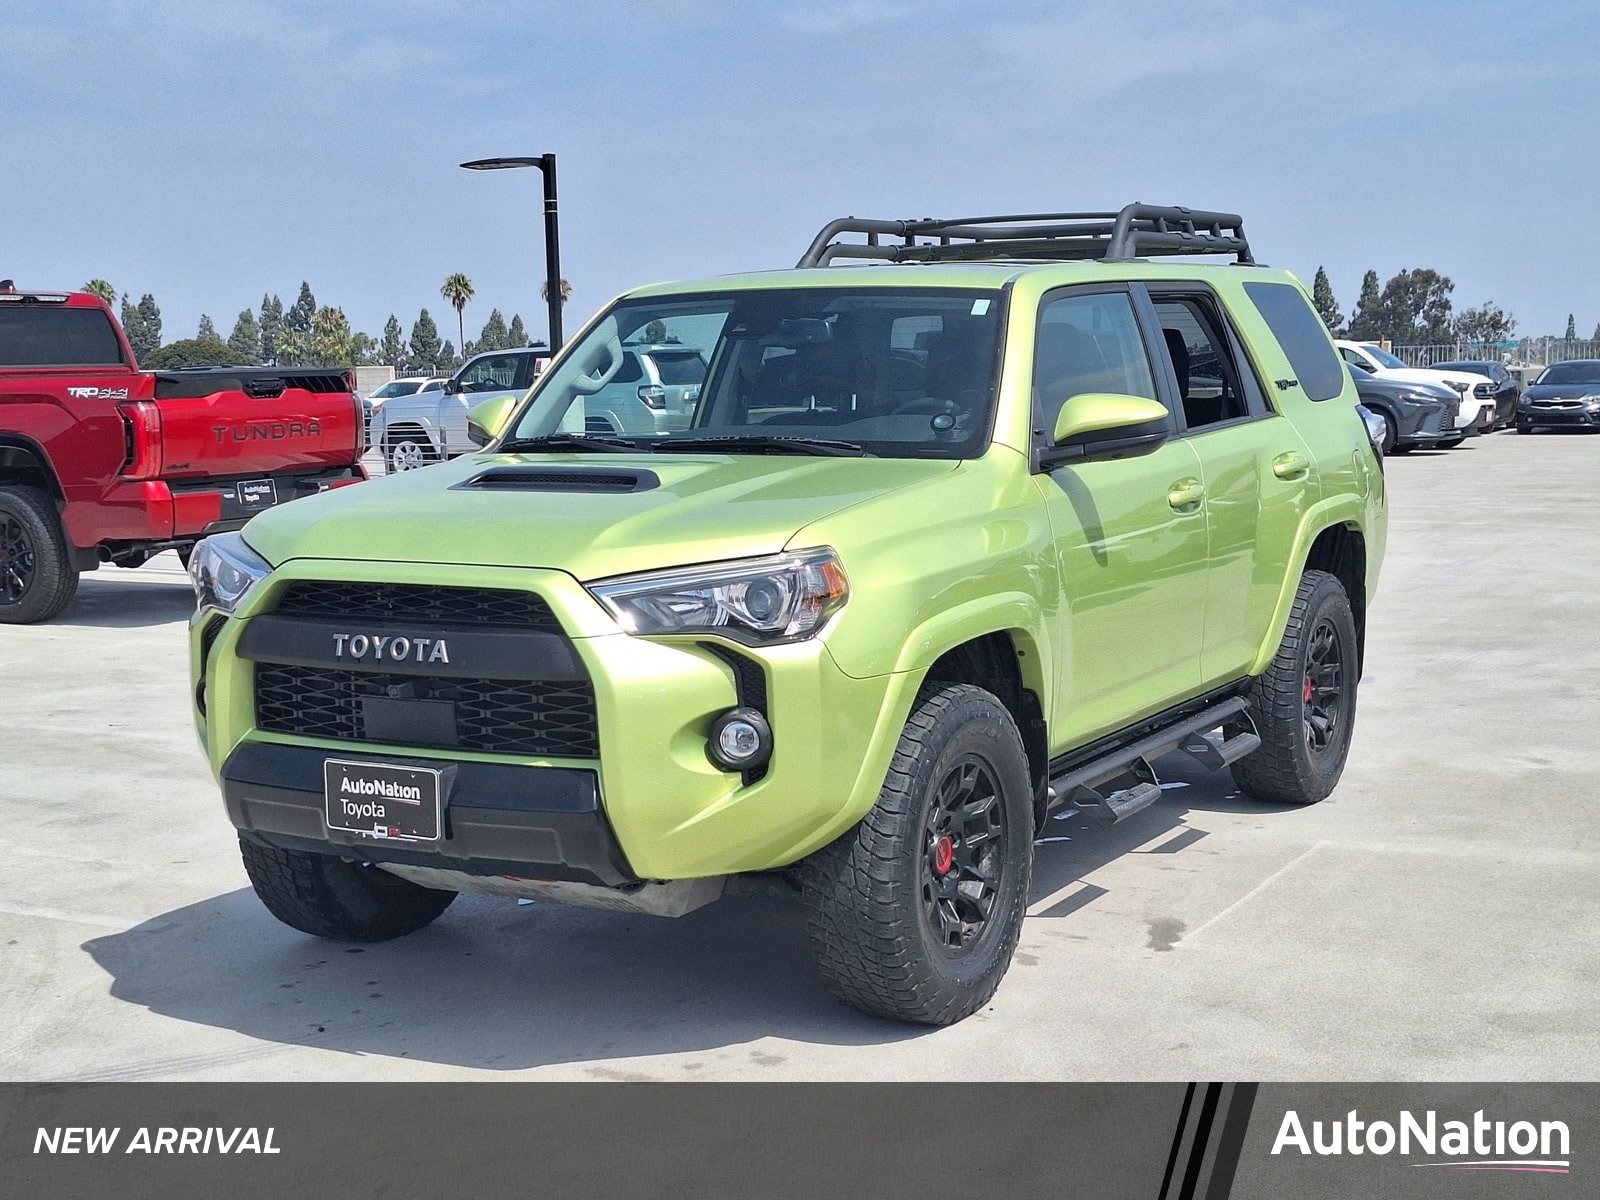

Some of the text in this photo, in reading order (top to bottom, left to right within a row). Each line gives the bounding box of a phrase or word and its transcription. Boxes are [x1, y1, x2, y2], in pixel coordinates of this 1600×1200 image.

[212, 421, 321, 443] TUNDRA
[332, 633, 449, 663] TOYOTA
[341, 776, 420, 800] AutoNation
[340, 798, 385, 819] Toyota
